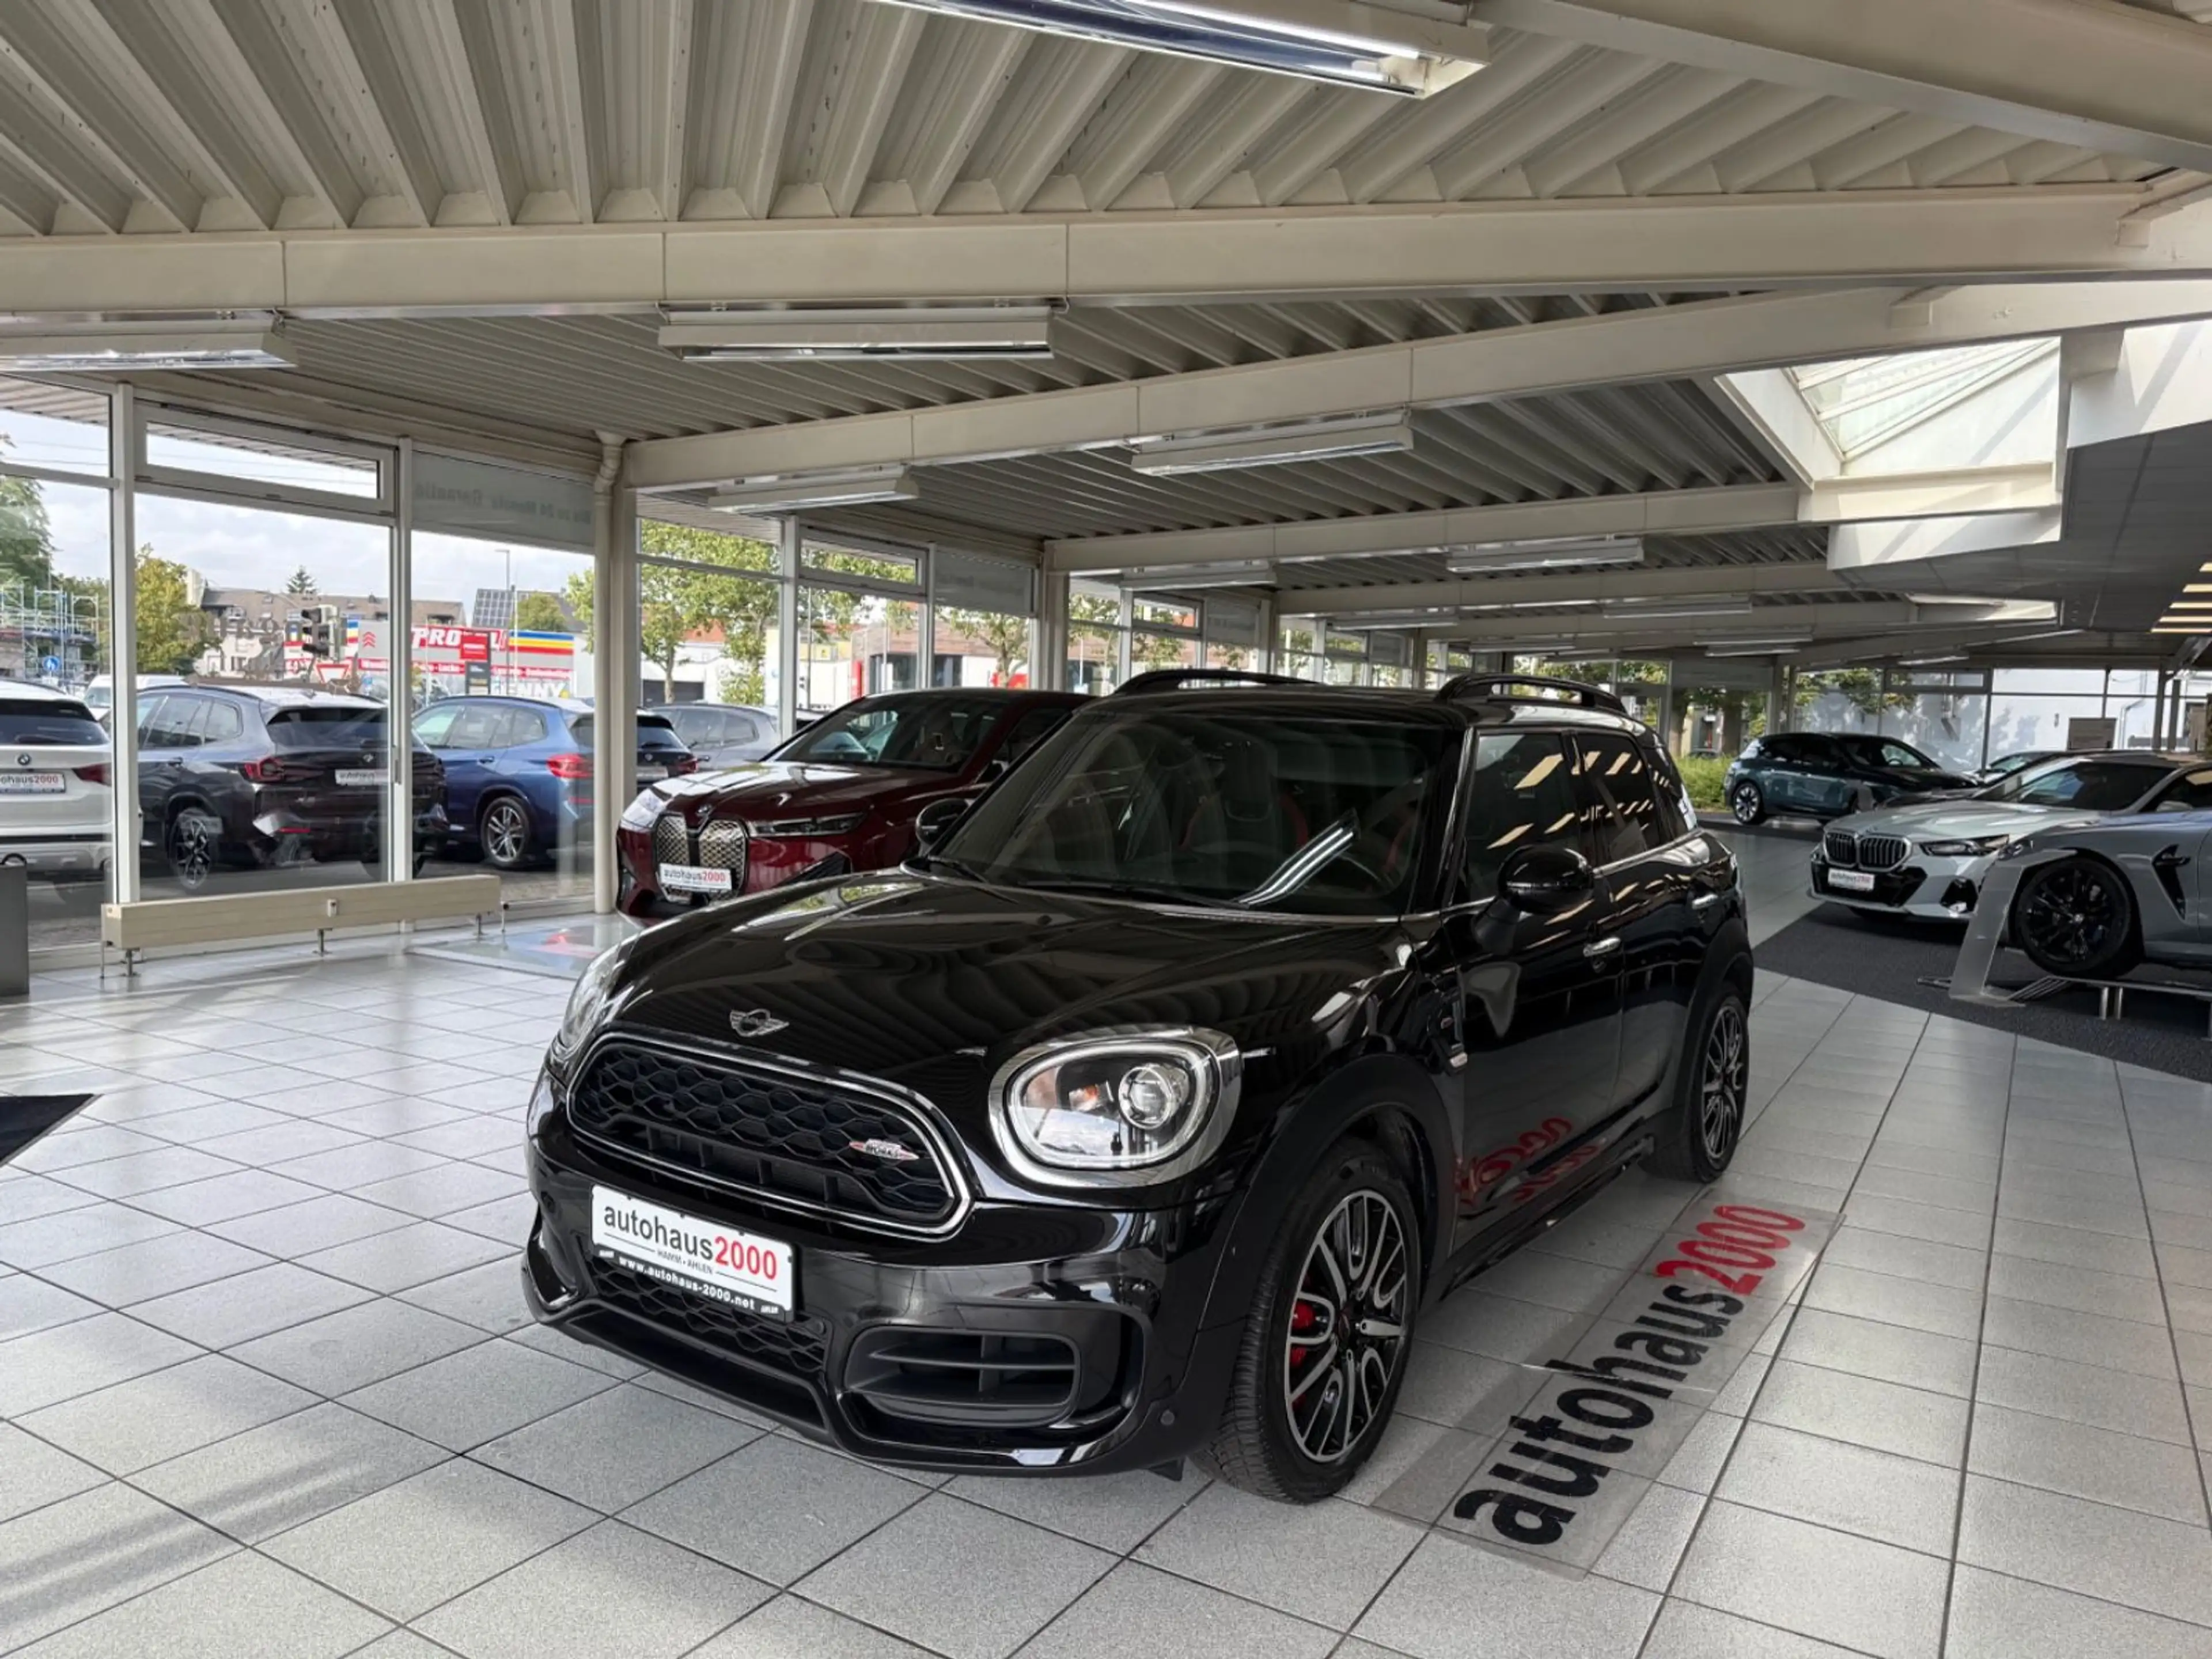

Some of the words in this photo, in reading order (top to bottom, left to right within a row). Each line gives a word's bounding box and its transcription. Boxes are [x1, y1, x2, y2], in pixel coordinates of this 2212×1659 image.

[664, 869, 726, 882] autohaus2000
[604, 1206, 777, 1281] autohaus2000
[619, 1256, 755, 1310] www.autohaus-2000.net
[1453, 1204, 1806, 1546] autohaus2000
